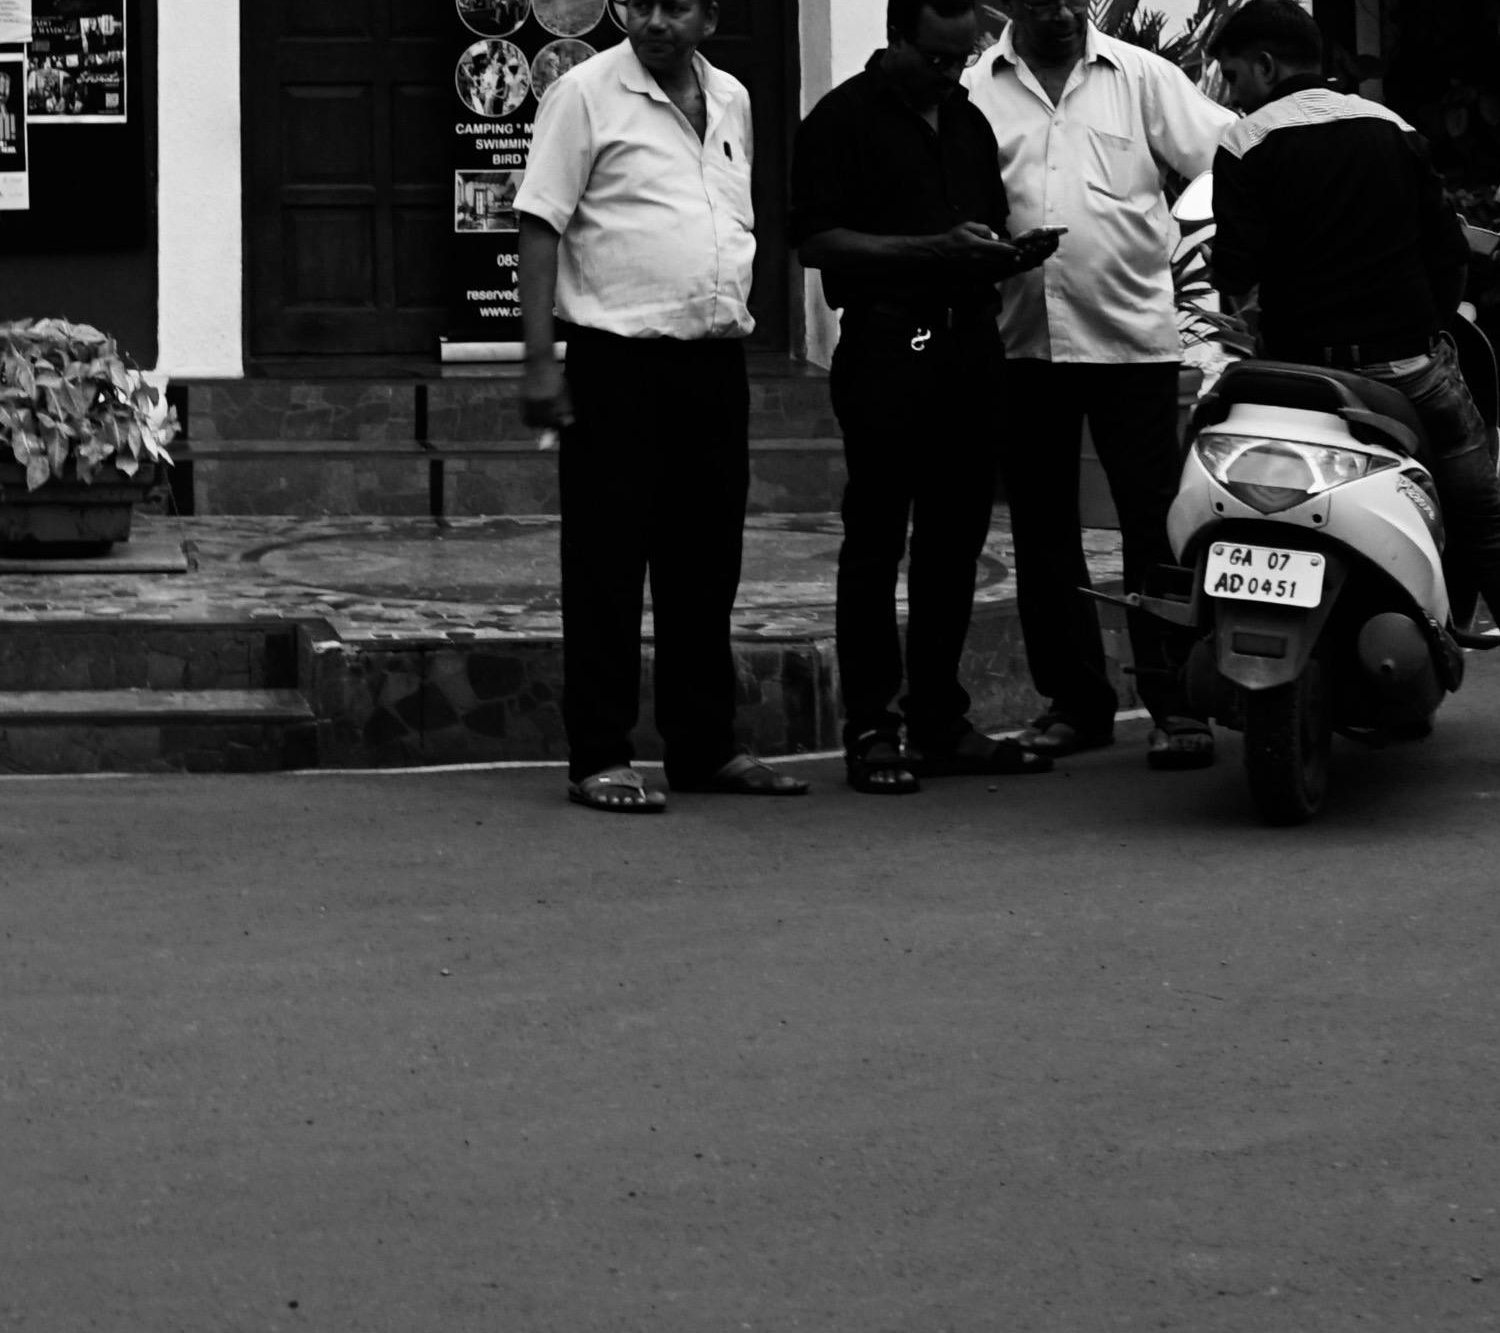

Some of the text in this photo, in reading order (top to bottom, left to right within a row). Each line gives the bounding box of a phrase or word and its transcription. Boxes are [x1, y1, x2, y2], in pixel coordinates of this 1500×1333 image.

[455, 122, 514, 135] CAMPING
[475, 138, 532, 151] SWIMMIN
[492, 153, 522, 166] BIRD
[1229, 547, 1291, 571] GA 07
